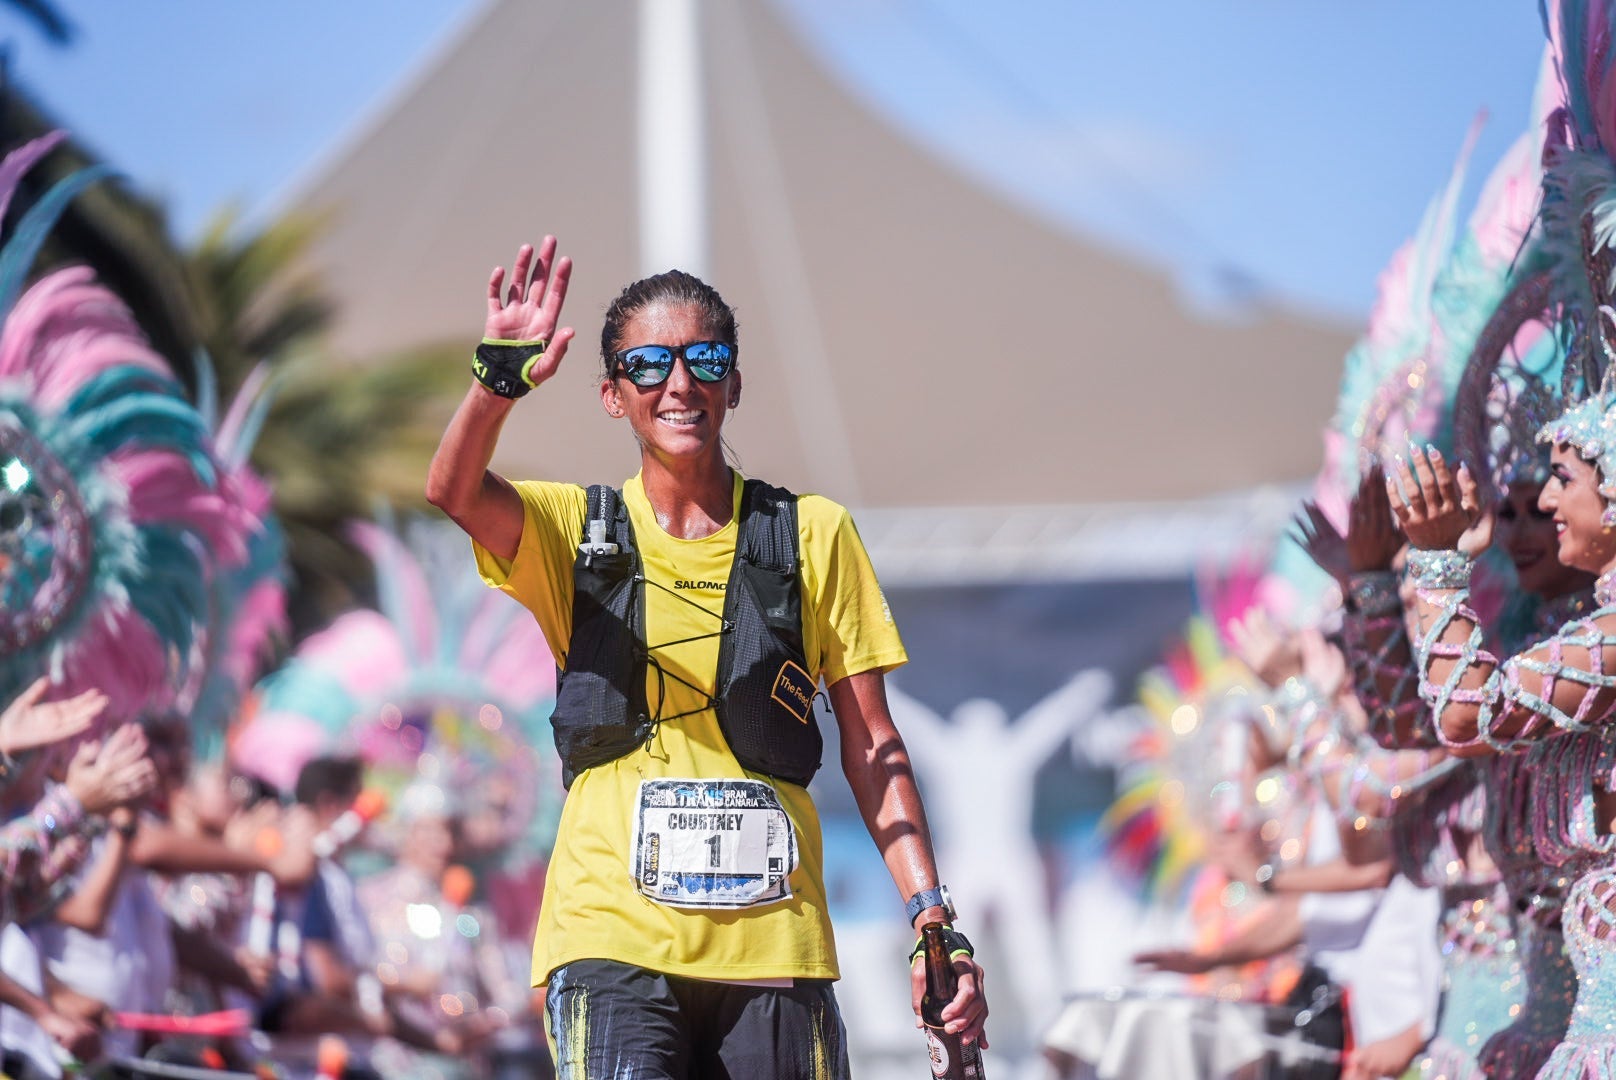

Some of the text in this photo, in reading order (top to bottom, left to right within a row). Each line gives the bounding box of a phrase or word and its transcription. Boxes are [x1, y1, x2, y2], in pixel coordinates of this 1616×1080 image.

[674, 580, 728, 590] SALOMO
[780, 675, 796, 694] The
[725, 789, 747, 800] GRAN
[724, 799, 758, 808] CANARIA
[668, 813, 744, 831] COURTNEY
[704, 834, 721, 868] 1
